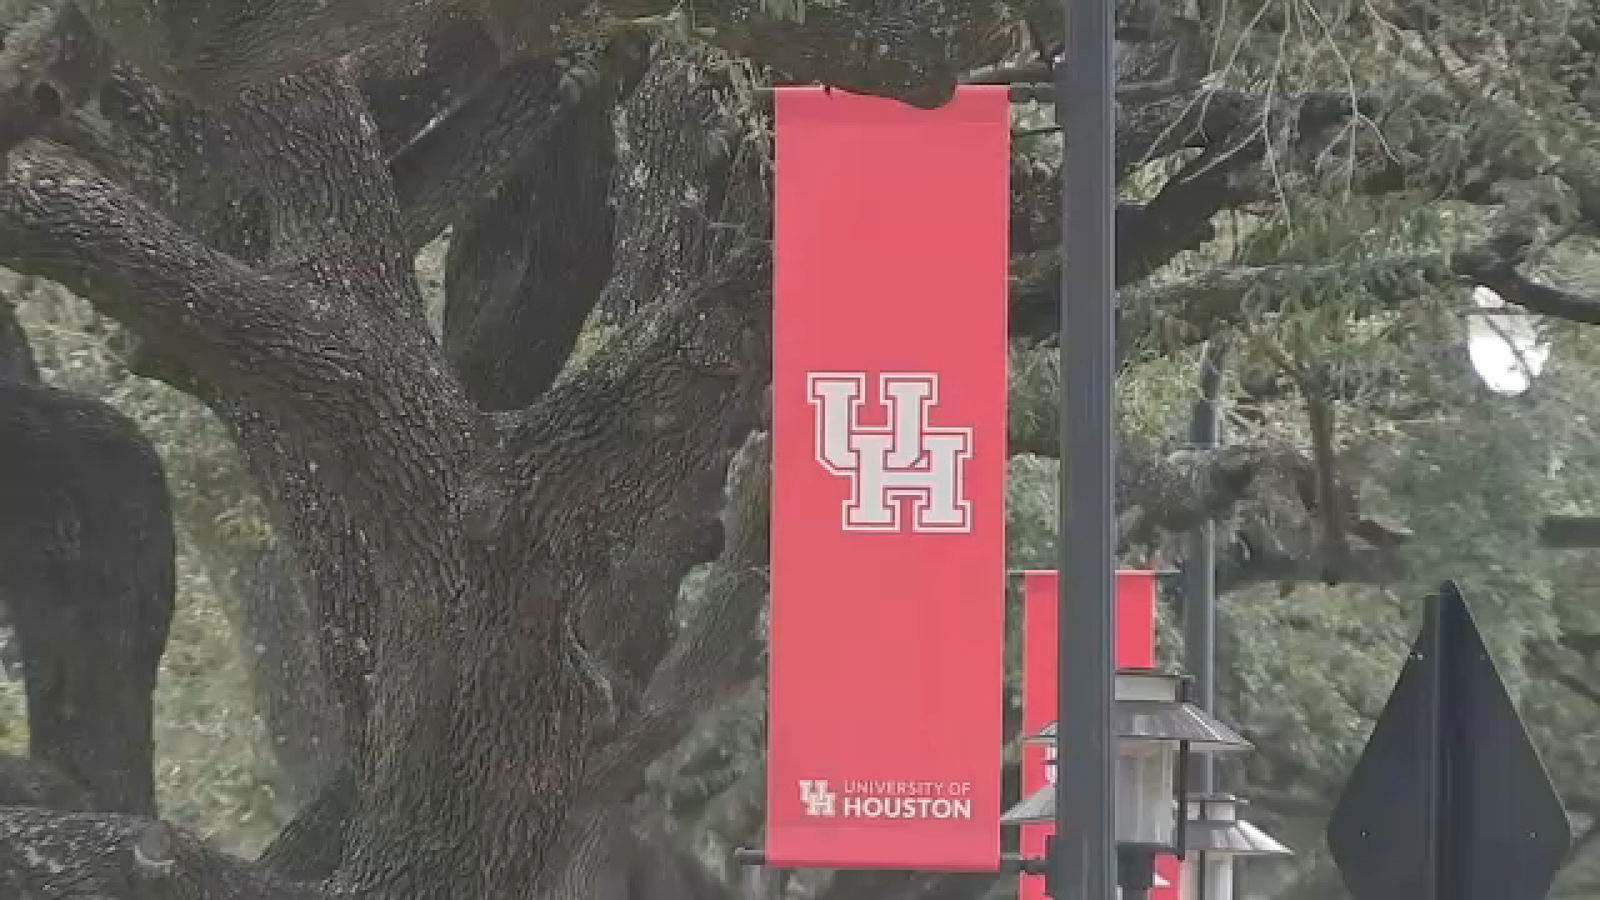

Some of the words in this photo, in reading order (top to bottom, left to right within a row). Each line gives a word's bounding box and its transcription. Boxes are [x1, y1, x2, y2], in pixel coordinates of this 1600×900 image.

[807, 372, 973, 533] UH
[844, 780, 943, 796] UNIVERSITY
[950, 782, 971, 796] OF
[844, 797, 971, 819] HOUSTON
